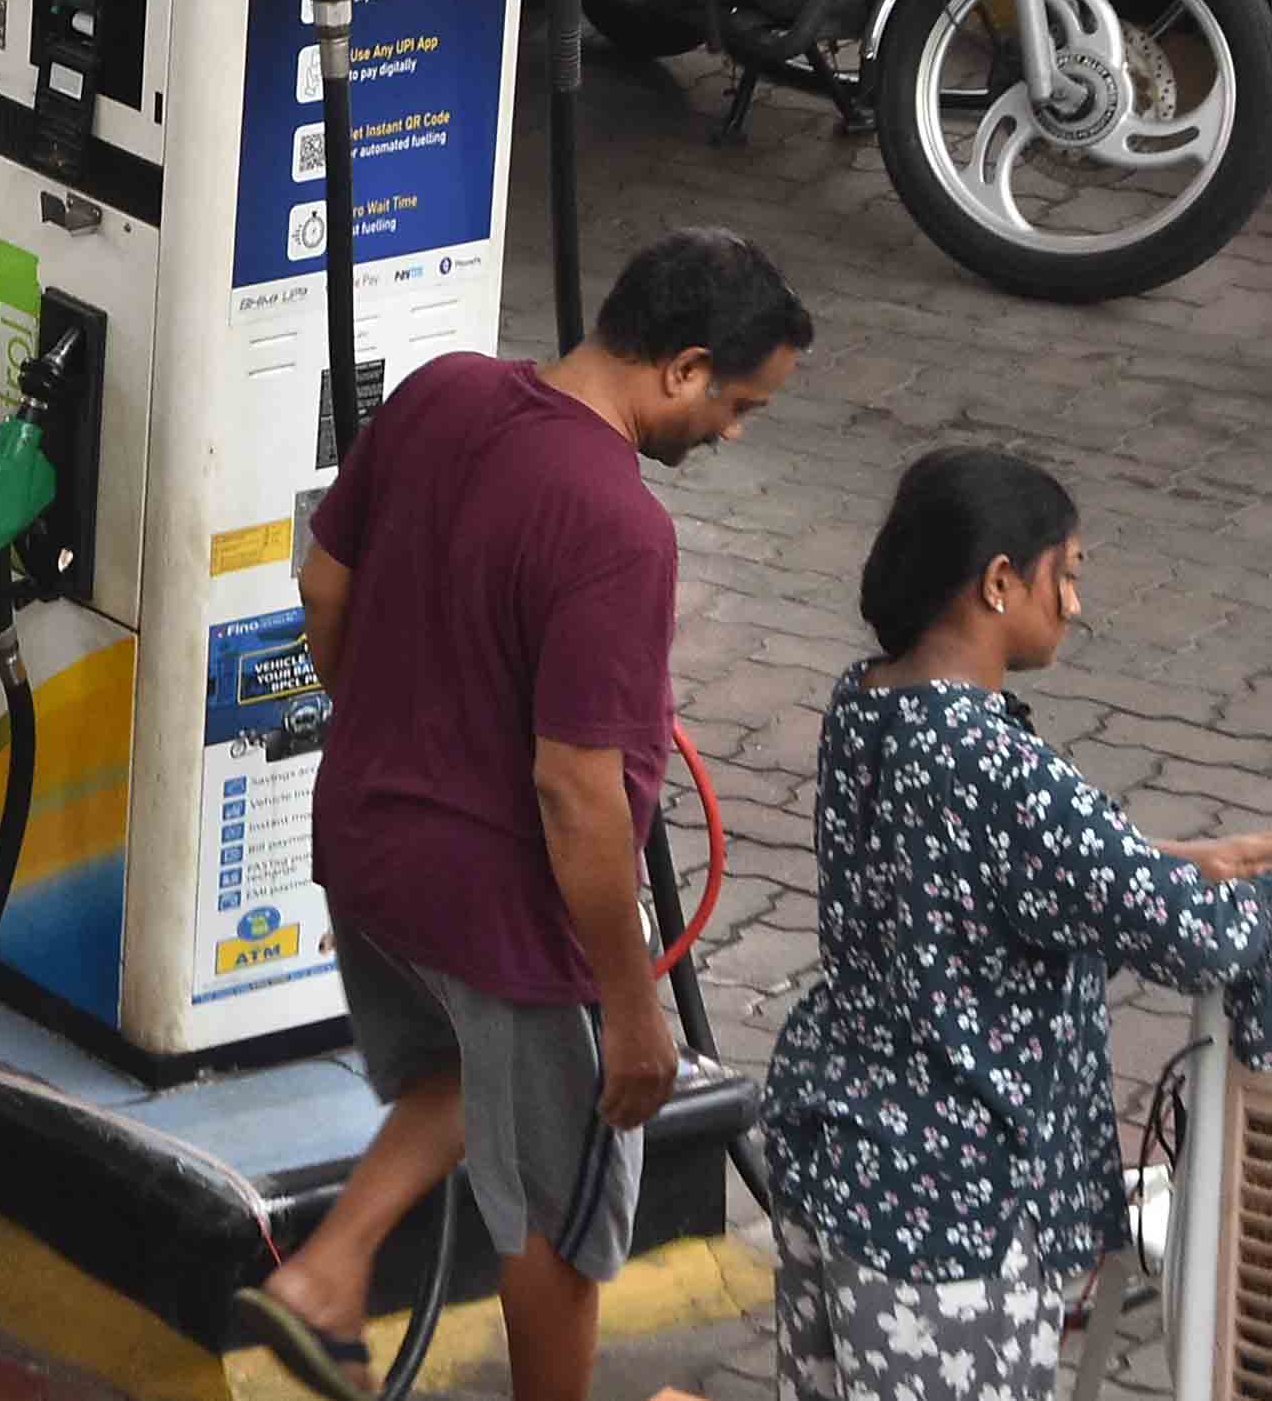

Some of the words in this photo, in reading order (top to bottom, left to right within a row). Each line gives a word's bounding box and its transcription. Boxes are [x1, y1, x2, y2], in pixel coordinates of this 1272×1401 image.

[350, 46, 370, 63] Use
[372, 44, 393, 61] Any
[396, 37, 415, 55] UPI
[417, 35, 439, 54] App
[349, 67, 359, 82] to
[360, 65, 378, 83] pay
[379, 57, 418, 78] digitally
[365, 119, 403, 139] Instant
[405, 112, 421, 130] QR
[423, 109, 451, 127] Code
[359, 134, 410, 159] automated
[411, 129, 447, 150] fuelling
[368, 198, 392, 217] Wait
[393, 194, 418, 211] Time
[361, 217, 397, 238] fuelling
[226, 618, 260, 637] Fino
[254, 652, 306, 673] VEHICLE
[256, 668, 292, 686] YOUR
[271, 678, 301, 694] BPCL
[249, 791, 292, 810] Vehicle
[234, 943, 282, 969] ATM
